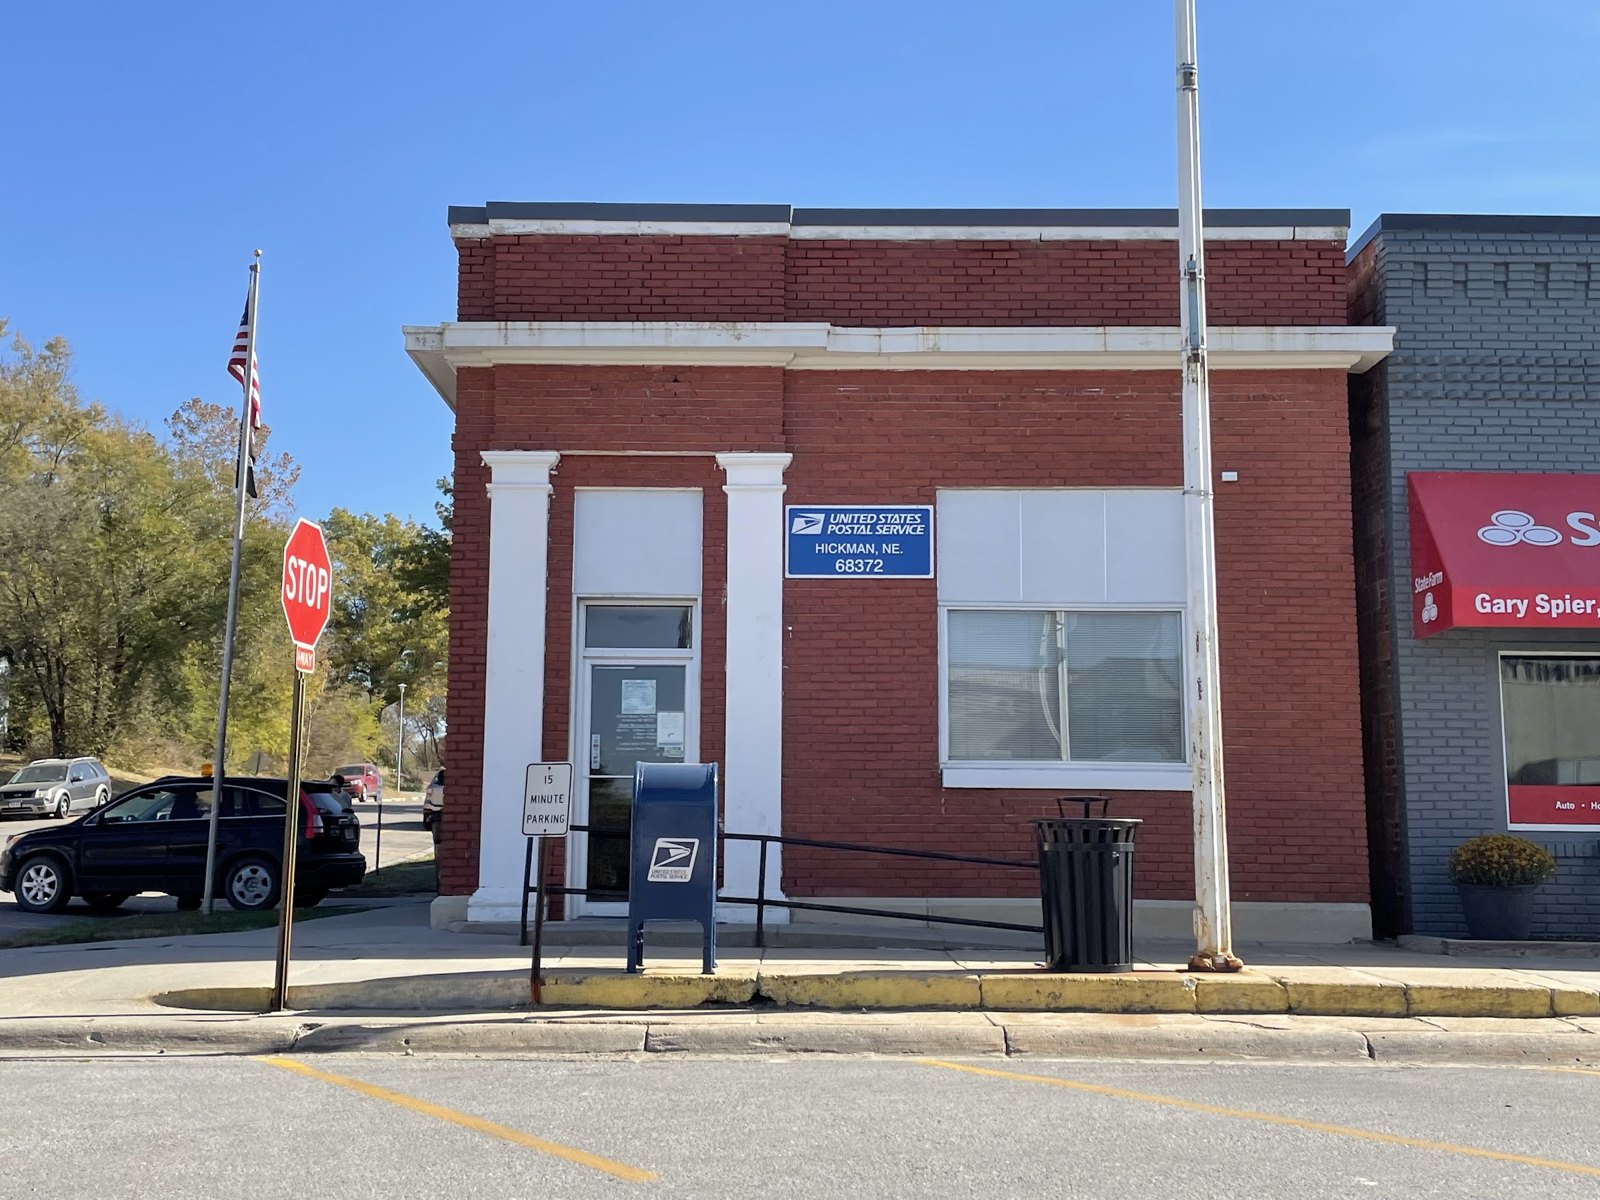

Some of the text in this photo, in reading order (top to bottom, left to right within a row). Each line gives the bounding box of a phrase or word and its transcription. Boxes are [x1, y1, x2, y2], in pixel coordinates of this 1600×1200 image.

[829, 513, 922, 524] UNITED STATES
[827, 524, 926, 535] POSTAL SERVICE
[1566, 511, 1600, 547] S
[815, 543, 904, 556] HICKMAN, NE.
[835, 559, 884, 573] 68372
[285, 555, 328, 610] STOP
[1475, 593, 1529, 618] Gary
[544, 775, 553, 784] 15
[530, 794, 565, 804] MINUTE
[1555, 800, 1576, 810] Auto
[526, 814, 565, 824] PARKING
